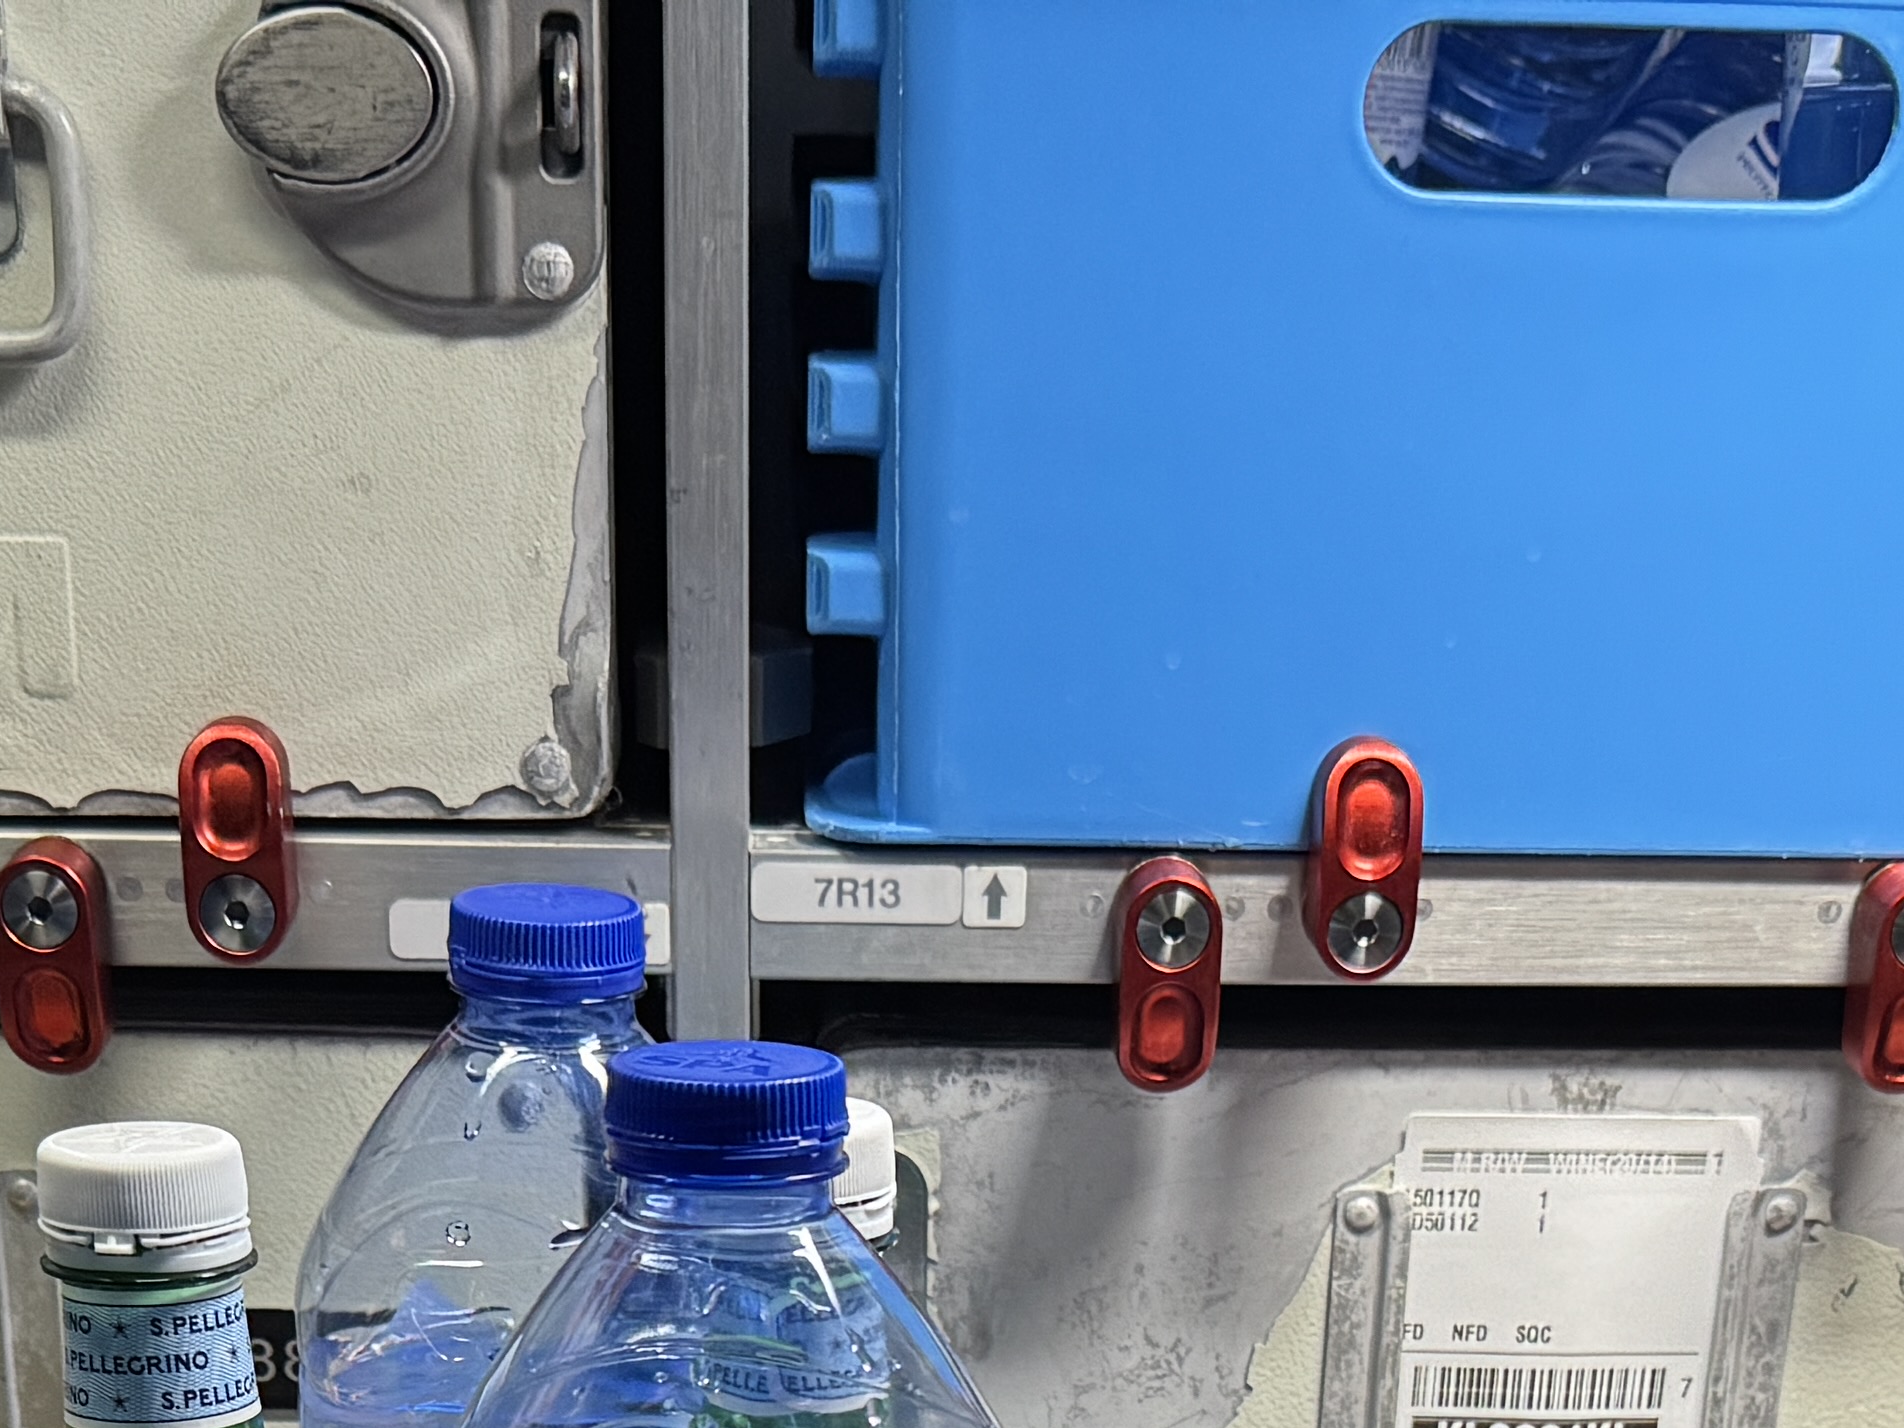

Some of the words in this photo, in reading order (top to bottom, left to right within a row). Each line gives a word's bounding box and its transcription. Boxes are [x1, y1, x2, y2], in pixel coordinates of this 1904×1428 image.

[814, 876, 902, 910] 7R13
[1451, 1325, 1489, 1343] NFD
[1679, 1378, 1694, 1400] 7
